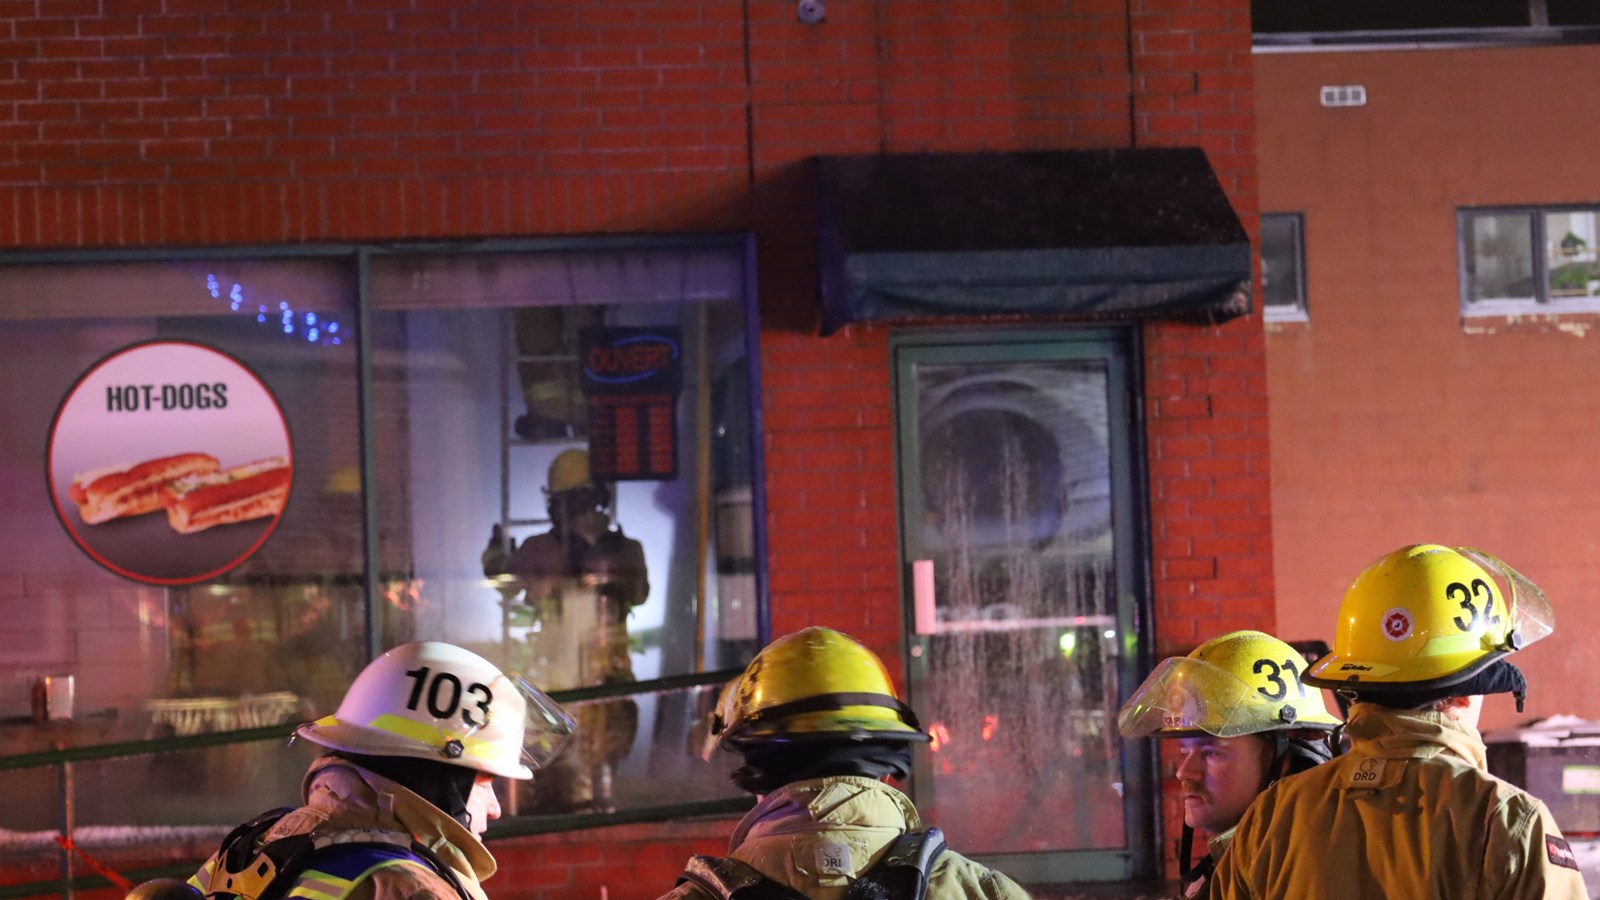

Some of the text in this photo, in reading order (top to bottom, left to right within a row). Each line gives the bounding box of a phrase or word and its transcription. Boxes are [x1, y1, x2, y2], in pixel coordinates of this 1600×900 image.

[588, 345, 672, 372] OUVERT
[106, 382, 228, 413] HOT-DOGS
[1446, 578, 1500, 632] 32
[405, 666, 493, 730] 103
[1253, 658, 1306, 702] 31
[1353, 772, 1377, 781] DRD
